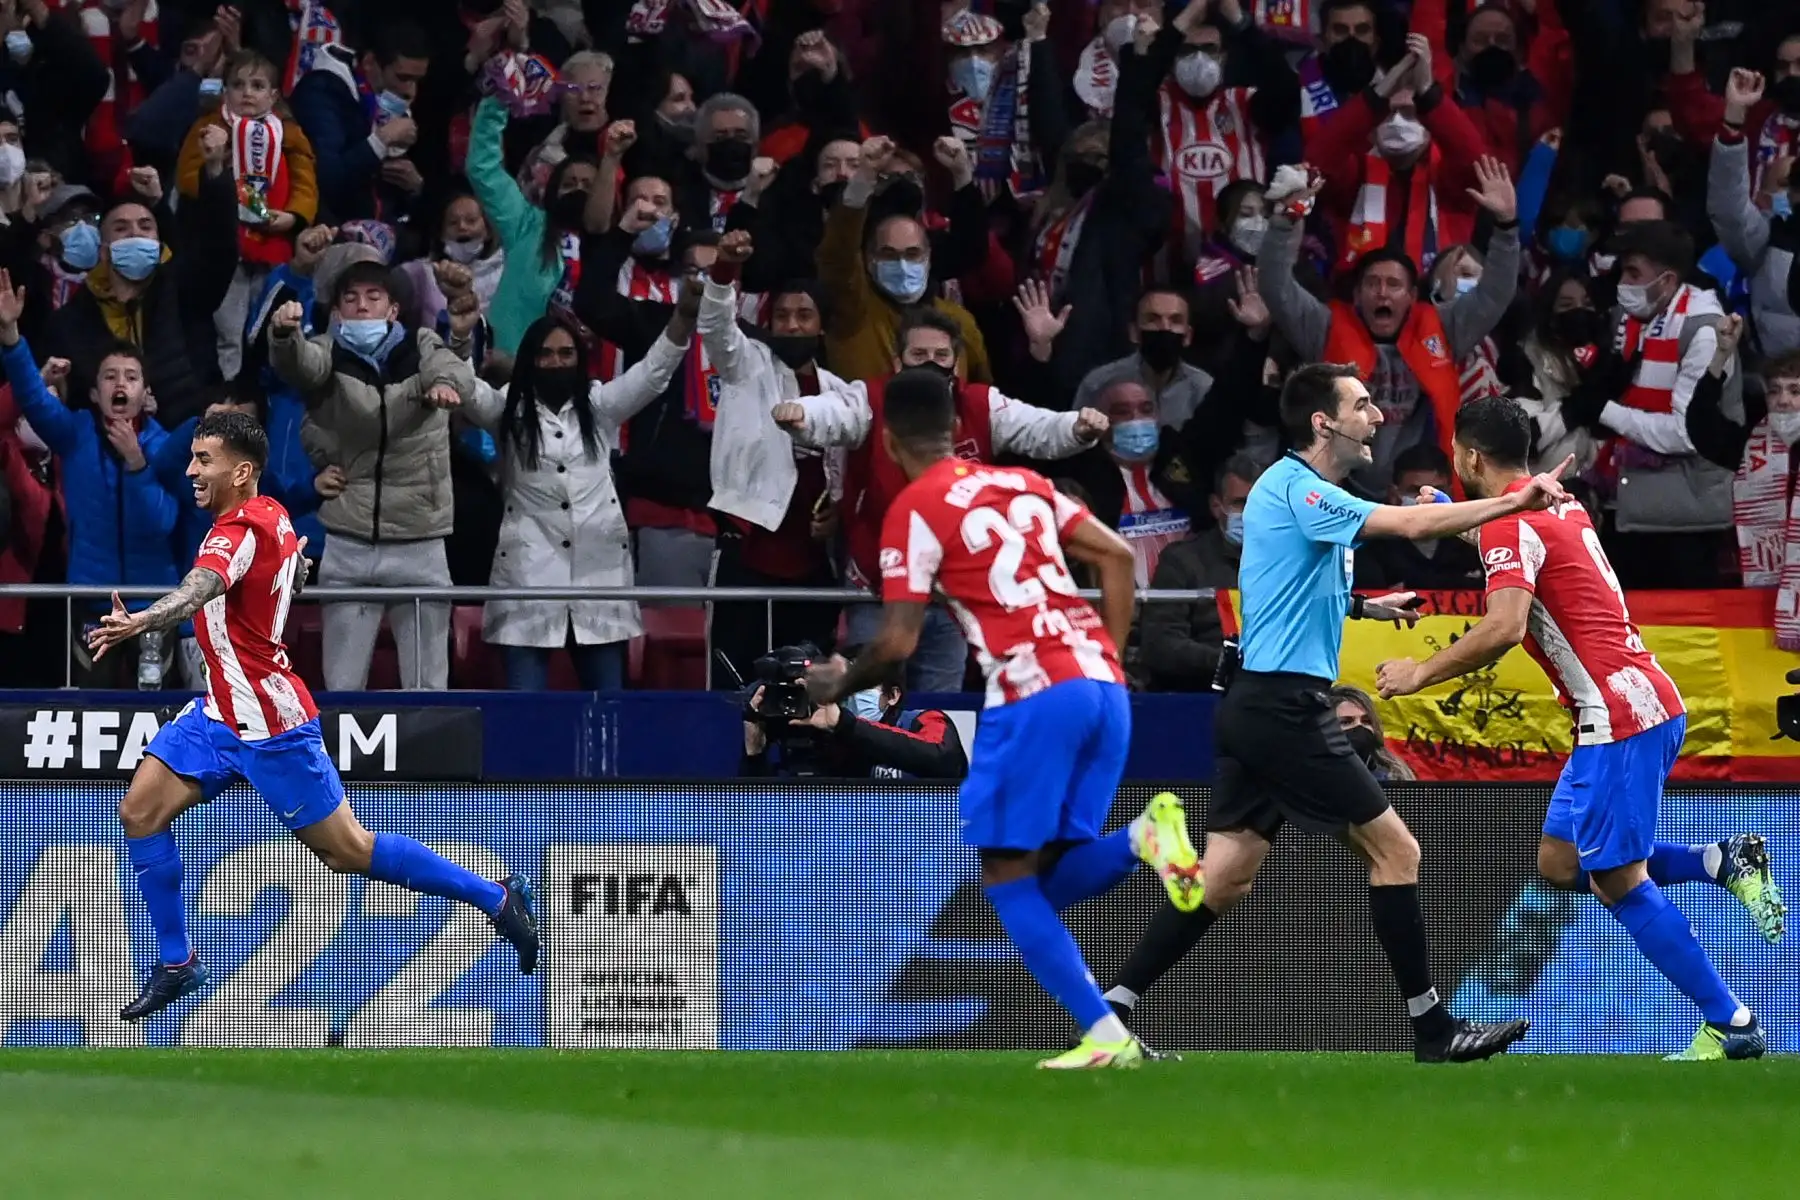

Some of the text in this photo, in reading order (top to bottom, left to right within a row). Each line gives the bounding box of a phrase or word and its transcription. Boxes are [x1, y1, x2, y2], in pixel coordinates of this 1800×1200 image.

[1184, 152, 1225, 171] KIA
[960, 493, 1080, 613] 23
[571, 873, 692, 915] FIFA
